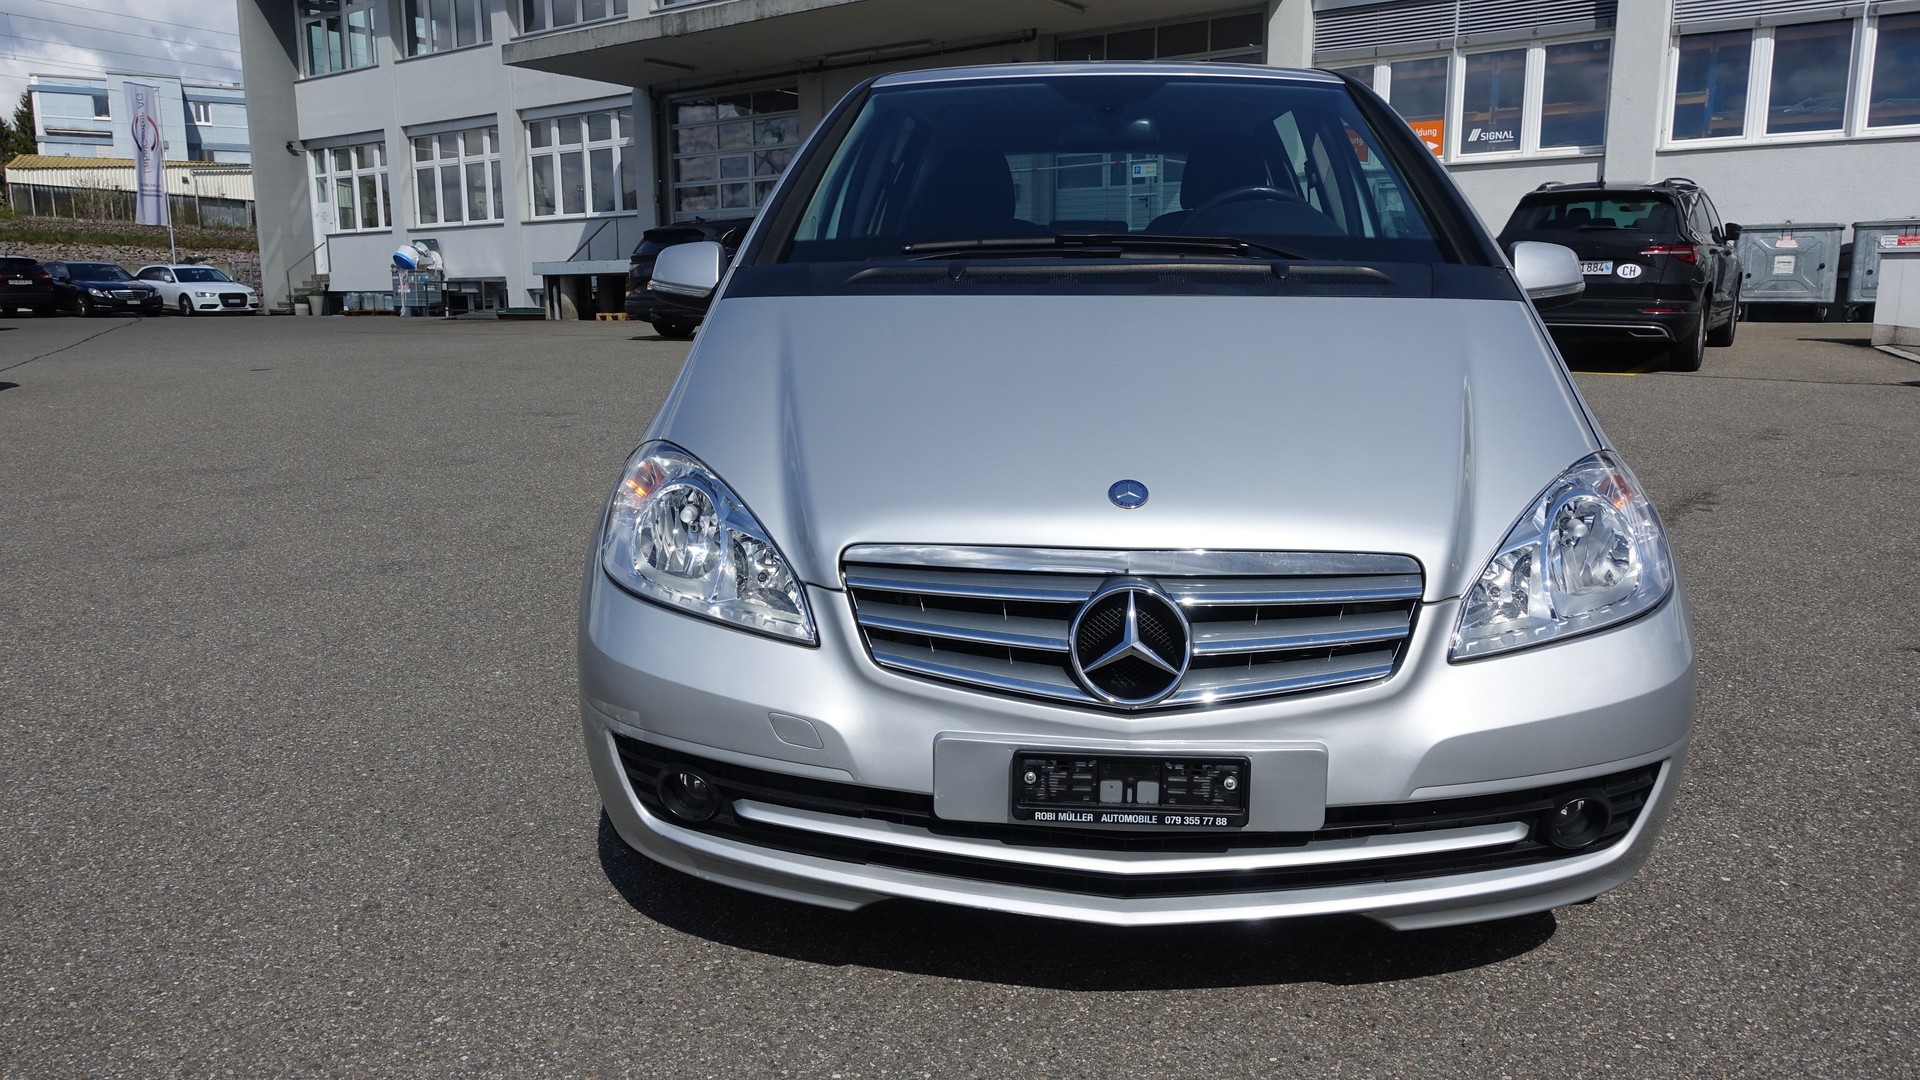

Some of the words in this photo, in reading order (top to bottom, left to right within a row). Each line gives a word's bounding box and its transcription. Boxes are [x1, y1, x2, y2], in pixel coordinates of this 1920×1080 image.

[1480, 130, 1514, 141] SIGNAL
[1622, 265, 1636, 277] CH
[1035, 811, 1056, 821] ROBI
[1058, 811, 1094, 822] MÜLLER
[1101, 813, 1158, 824] AUTOMOBILE
[1165, 815, 1181, 825] 079
[1183, 816, 1200, 826] 355
[1202, 816, 1214, 826] 77
[1215, 817, 1227, 826] 88
